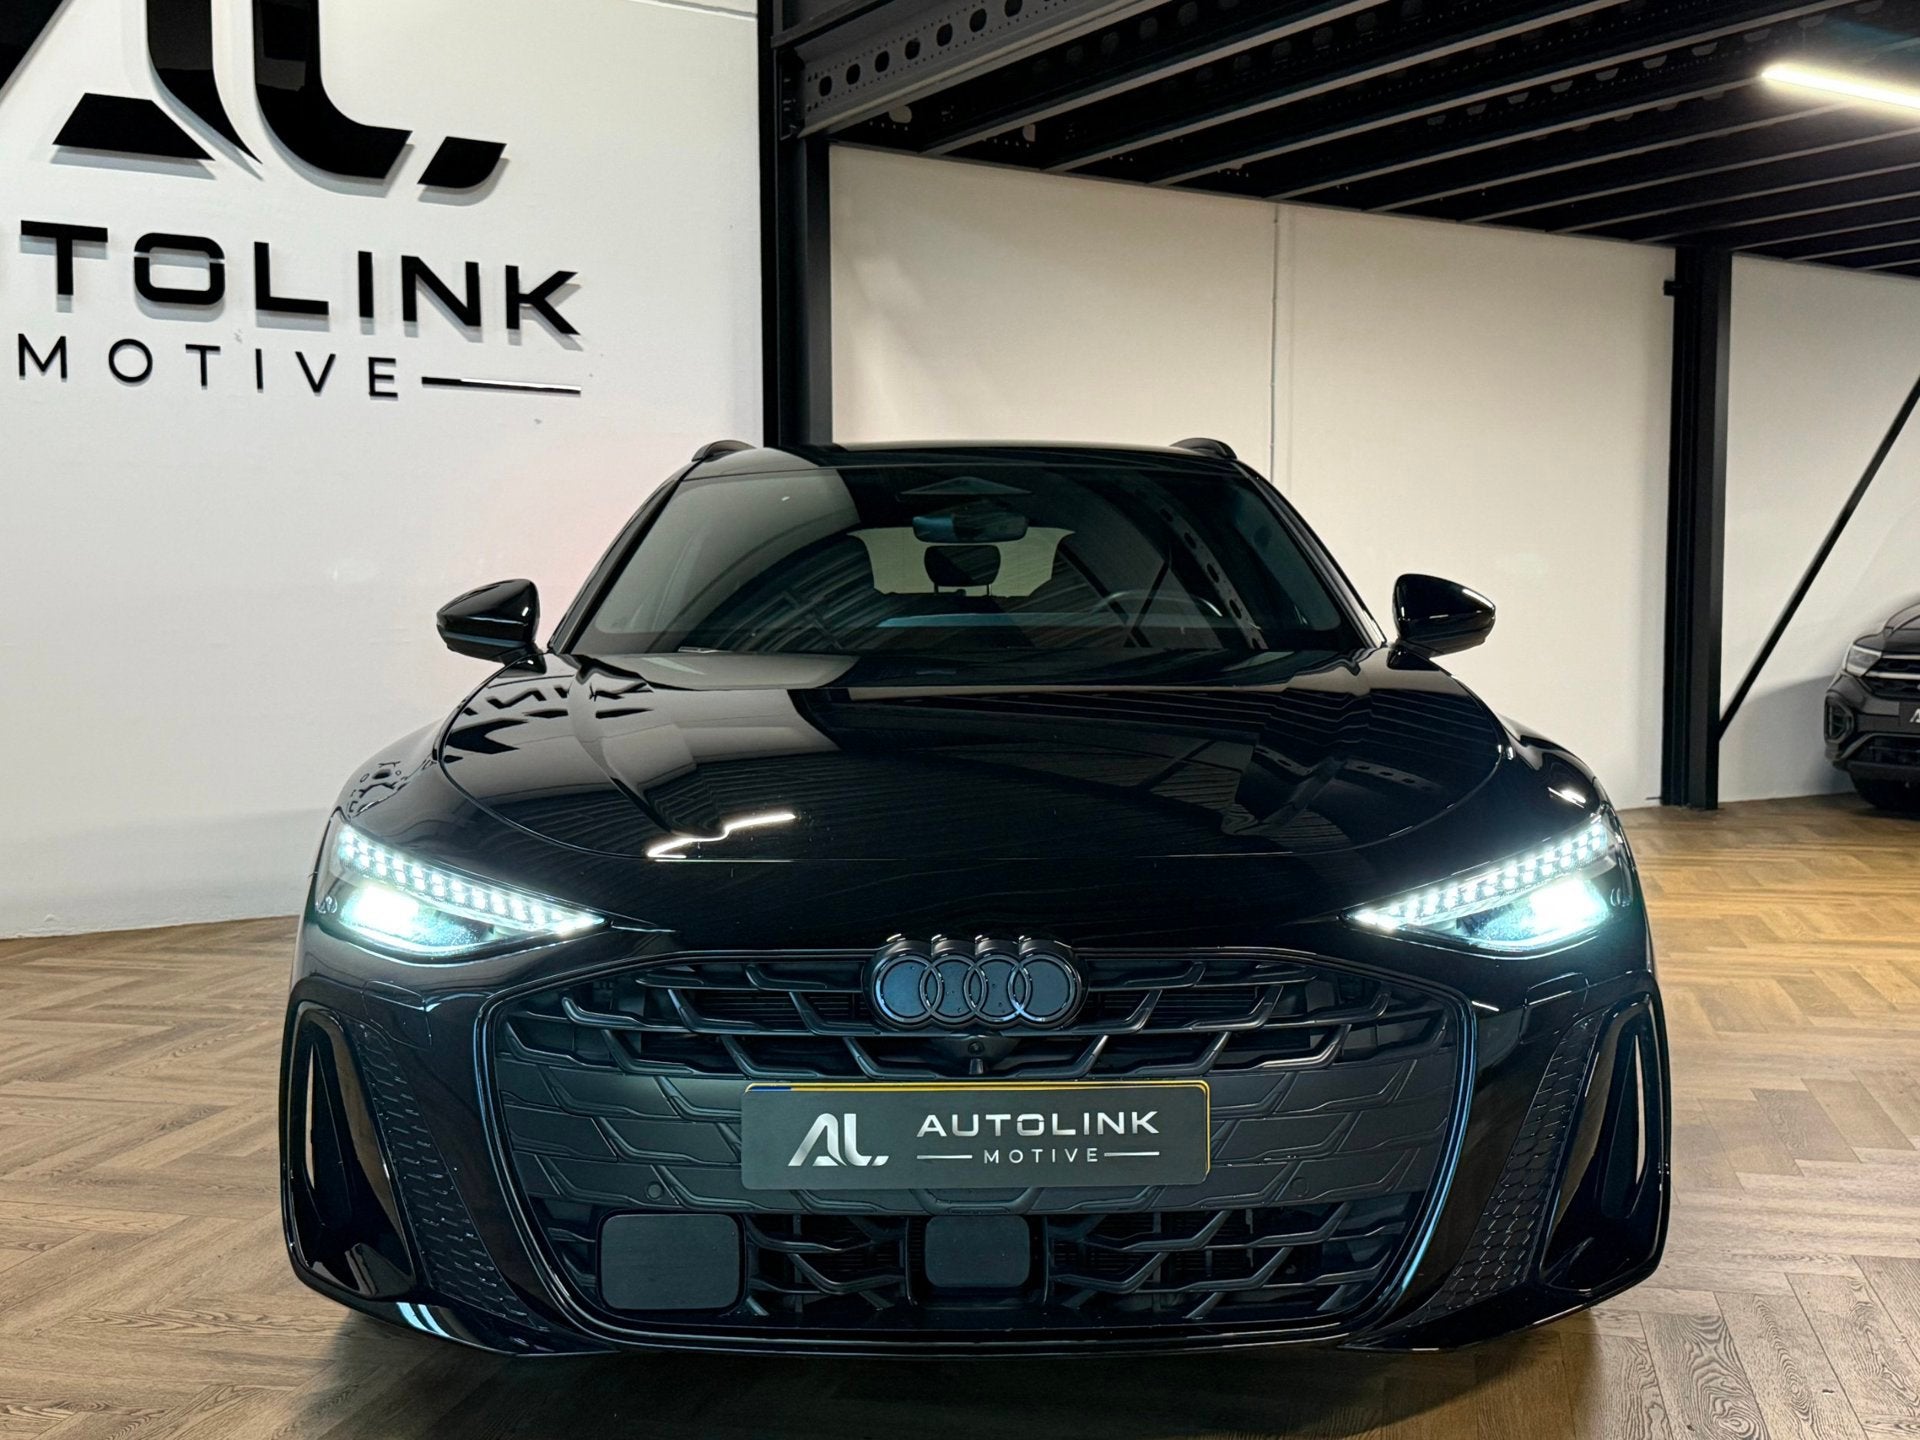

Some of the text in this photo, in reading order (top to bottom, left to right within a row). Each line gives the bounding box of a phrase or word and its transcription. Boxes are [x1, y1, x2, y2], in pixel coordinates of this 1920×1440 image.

[20, 219, 581, 335] TOLINK
[17, 332, 399, 397] MOTIVE
[916, 1110, 1160, 1138] AUTOLINK
[984, 1147, 1099, 1165] MOTIVE
